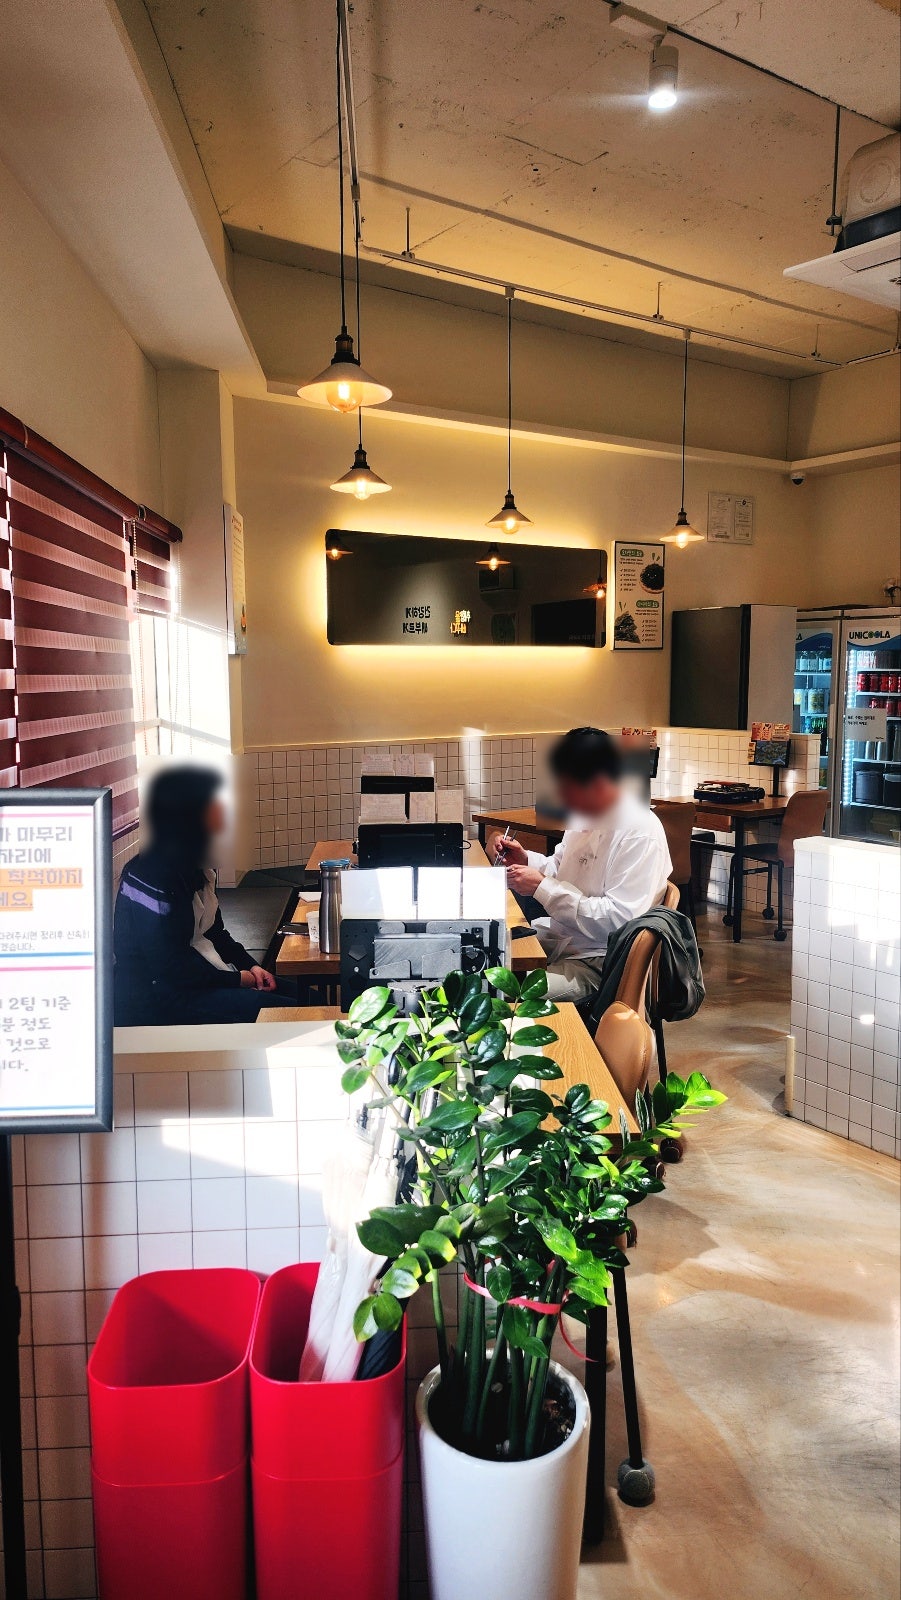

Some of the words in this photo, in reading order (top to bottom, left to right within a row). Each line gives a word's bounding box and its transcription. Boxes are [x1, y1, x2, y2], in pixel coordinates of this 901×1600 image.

[848, 630, 891, 640] UNICOOLA
[17, 826, 73, 842] 마무리
[41, 996, 72, 1011] 기준
[20, 1017, 52, 1032] 정도
[6, 1037, 52, 1053] 것으로
